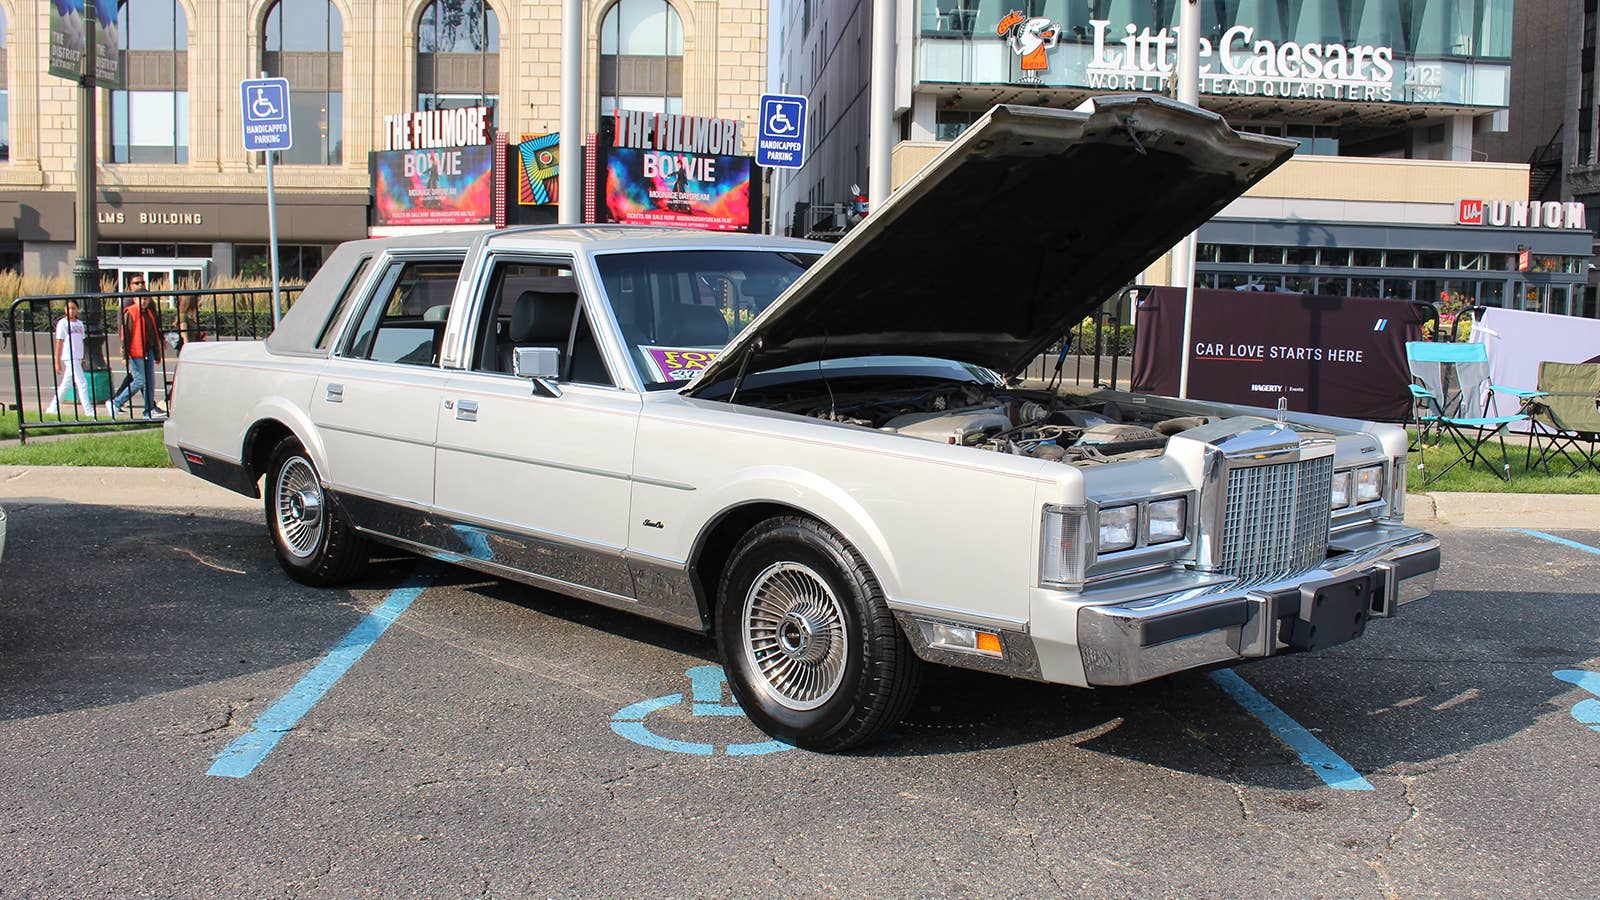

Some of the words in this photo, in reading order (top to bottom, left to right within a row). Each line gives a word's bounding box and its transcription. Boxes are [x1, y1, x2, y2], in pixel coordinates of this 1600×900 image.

[52, 31, 64, 45] THE
[52, 45, 80, 62] DISTRICT
[1088, 20, 1212, 73] Litte
[1219, 25, 1393, 83] Caesars
[246, 124, 288, 134] HANDICAPPED
[384, 112, 412, 151] THE
[413, 106, 488, 149] FILLMORE
[616, 109, 654, 149] THE
[656, 113, 746, 156] FILLMORE
[254, 134, 281, 144] PARKING
[760, 140, 802, 151] HANDICAPPED
[767, 151, 793, 161] PARKING
[404, 152, 462, 177] BOWIE
[643, 154, 716, 182] BOWIE
[649, 190, 678, 199] MOONAGE
[679, 192, 710, 200] DAYDREAM
[97, 213, 125, 224] LMS
[140, 213, 203, 224] BUILDING
[1489, 200, 1587, 229] UNION
[141, 247, 155, 255] 2111
[1195, 342, 1224, 356] CAR
[1229, 344, 1264, 358] LOVE
[1269, 346, 1322, 360] STARTS
[1328, 349, 1363, 363] HERE
[1251, 384, 1282, 392] HAGERTY
